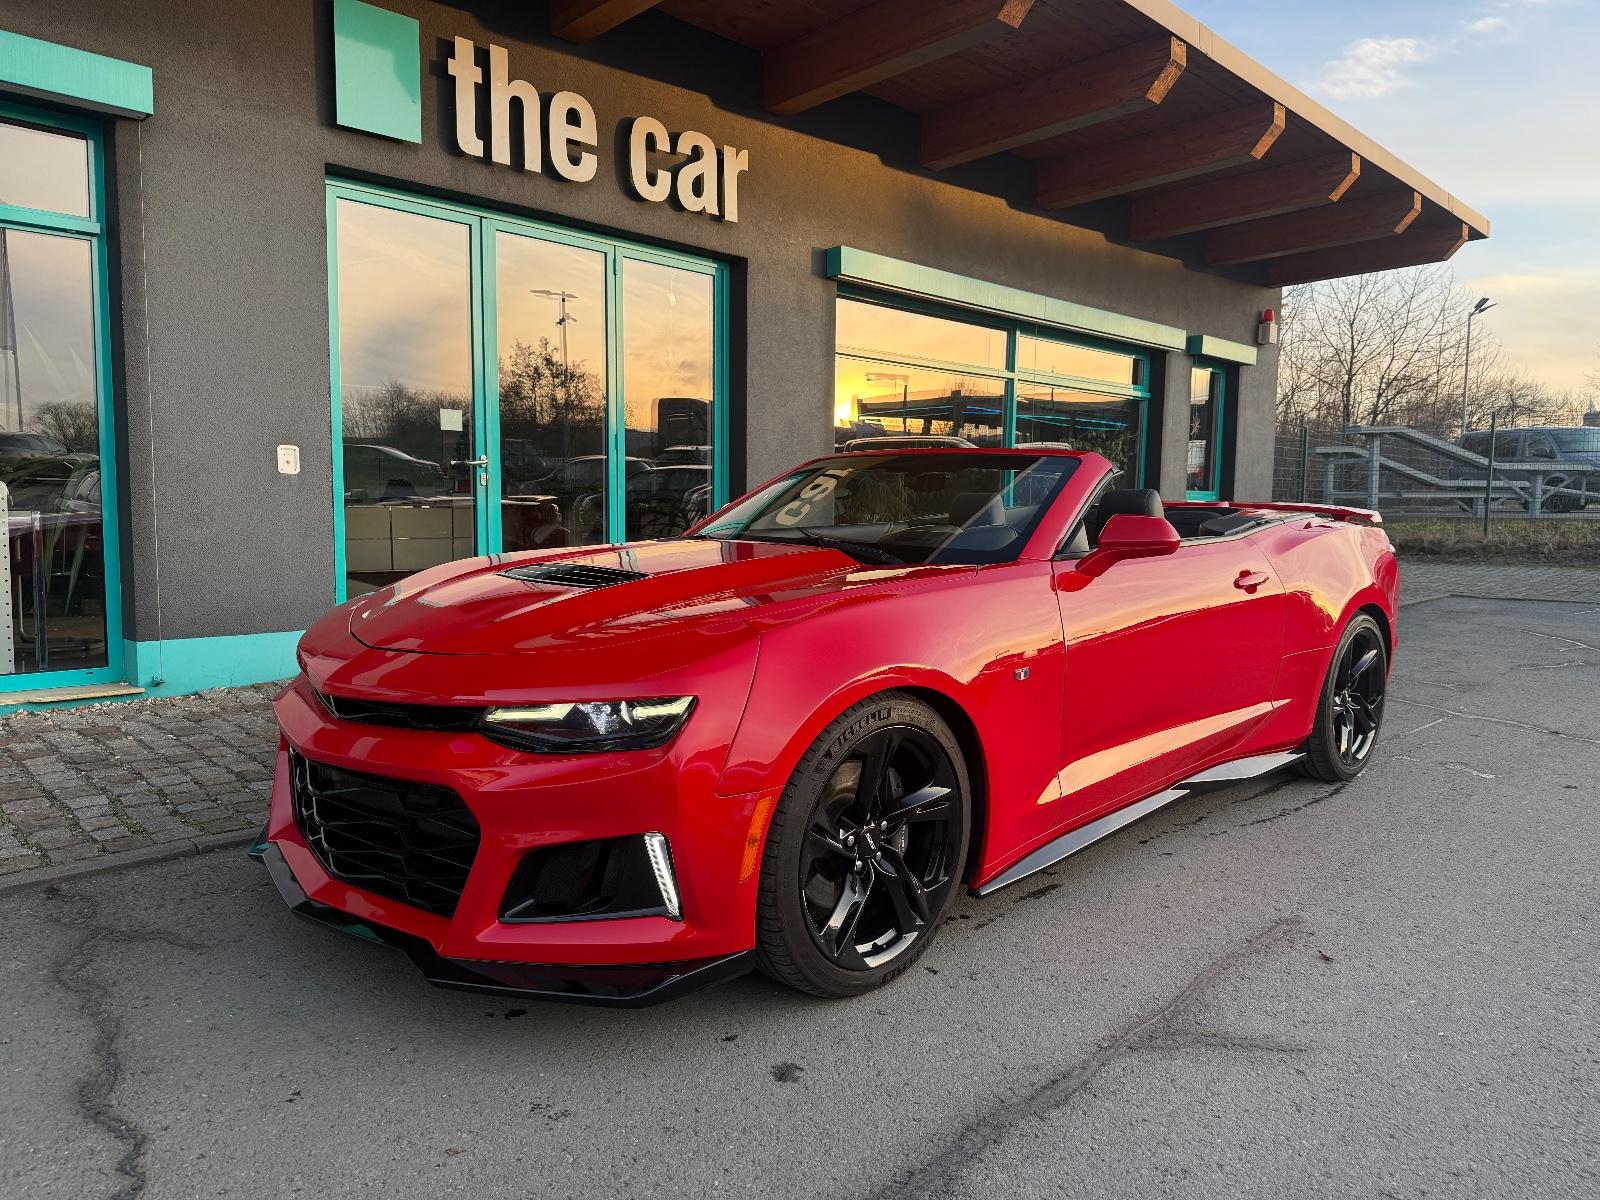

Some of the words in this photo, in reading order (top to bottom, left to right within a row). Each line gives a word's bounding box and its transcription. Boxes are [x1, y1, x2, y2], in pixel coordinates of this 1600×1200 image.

[448, 36, 598, 182] the
[630, 116, 748, 222] car
[829, 707, 892, 756] MICHELIN
